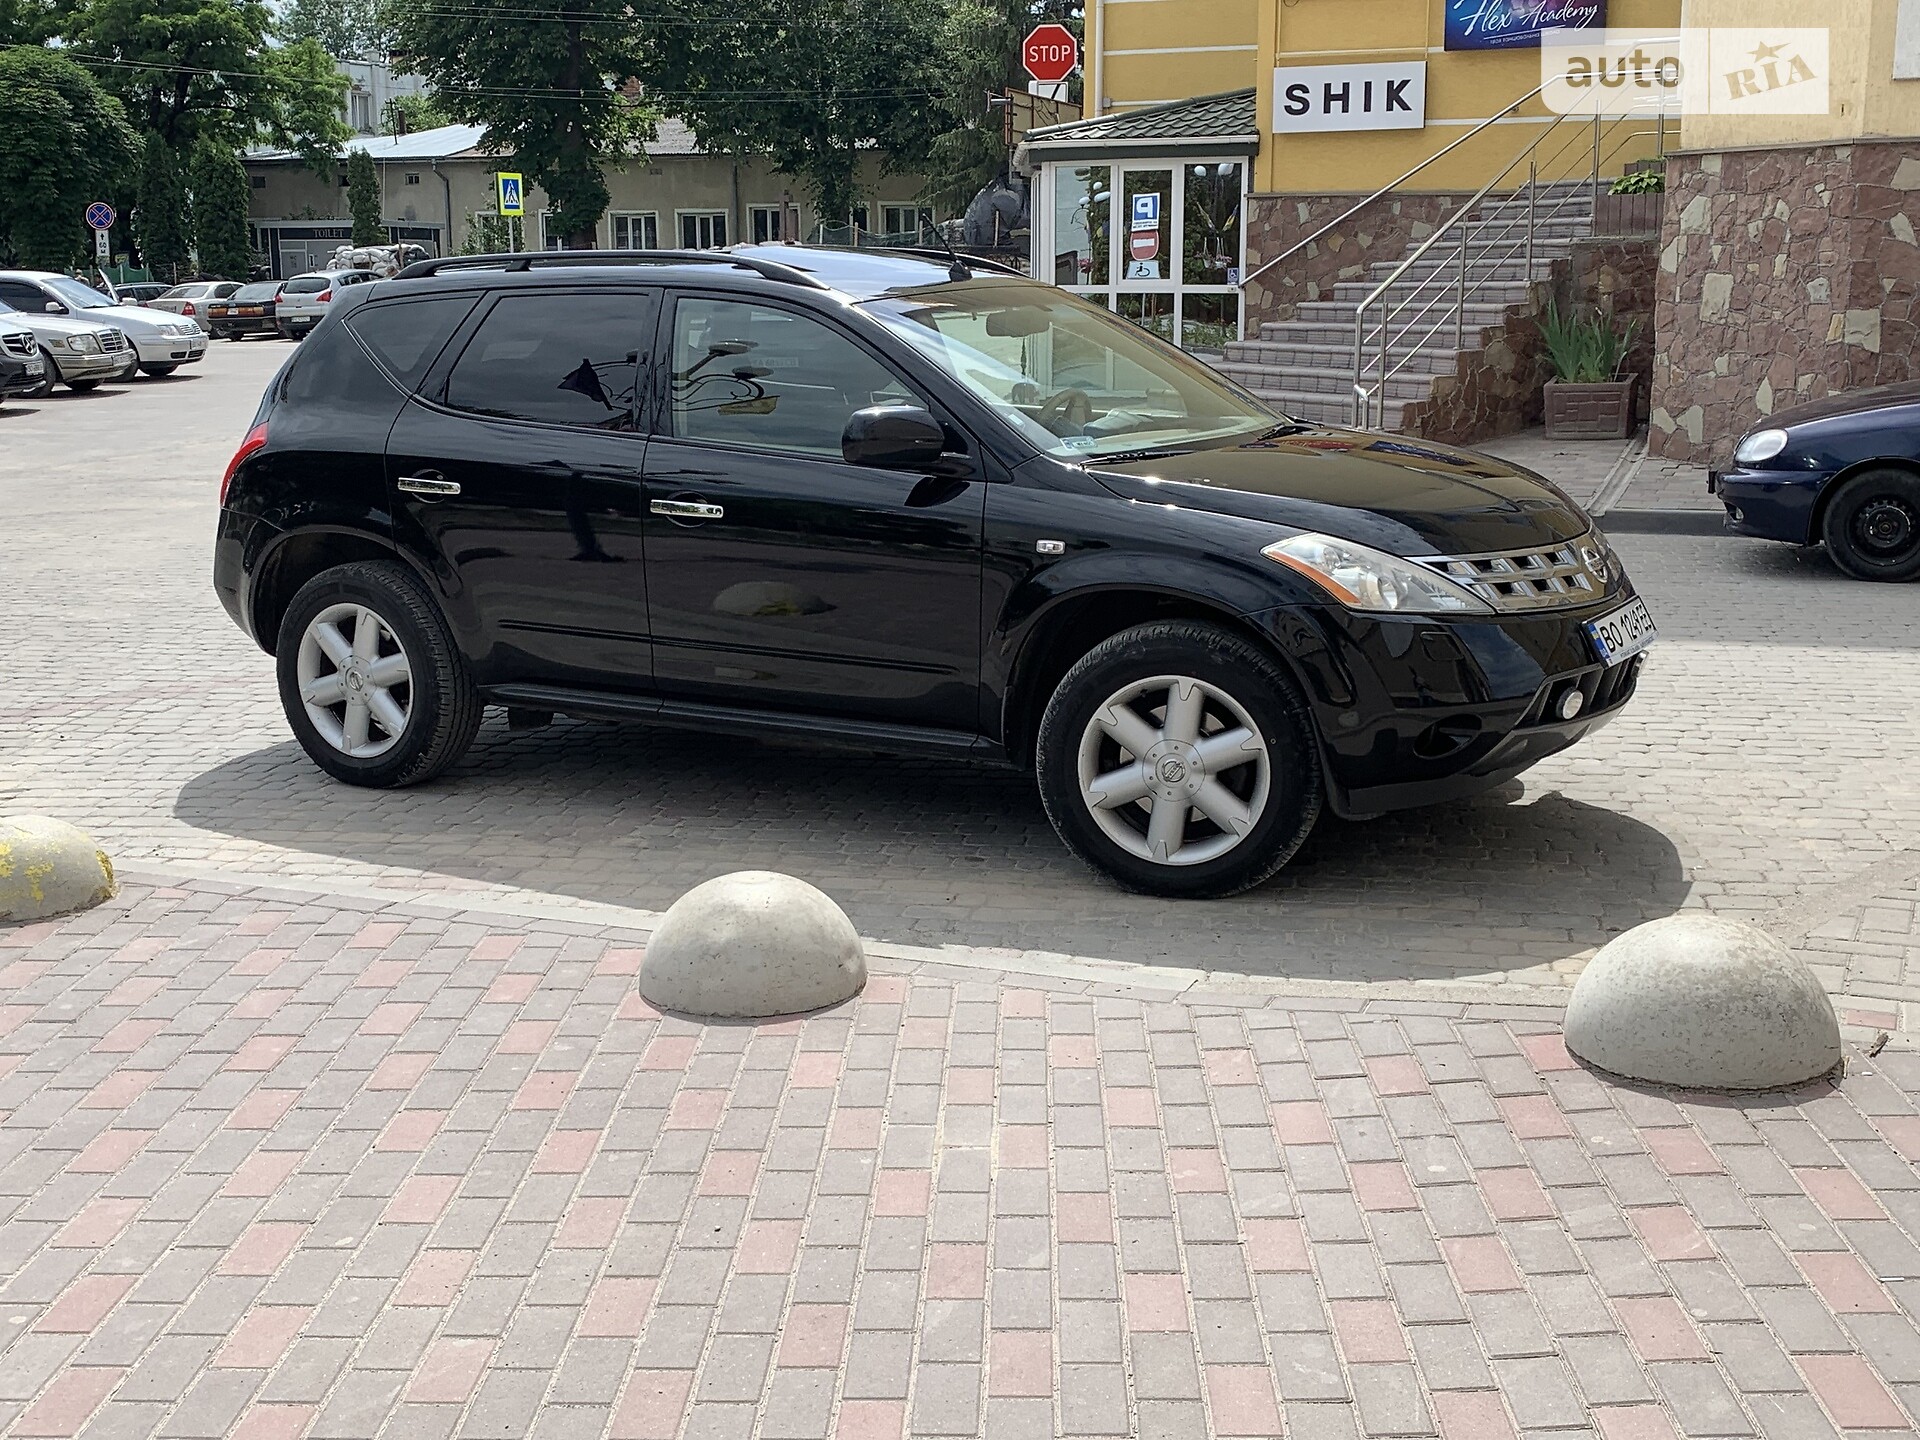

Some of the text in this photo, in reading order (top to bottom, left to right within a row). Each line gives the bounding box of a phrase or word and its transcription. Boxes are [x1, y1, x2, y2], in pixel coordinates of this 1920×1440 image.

[1519, 0, 1598, 31] Academy
[1029, 45, 1071, 62] STOP
[1284, 79, 1412, 116] SHIK
[313, 228, 344, 238] TOILET
[1599, 621, 1624, 653] BO
